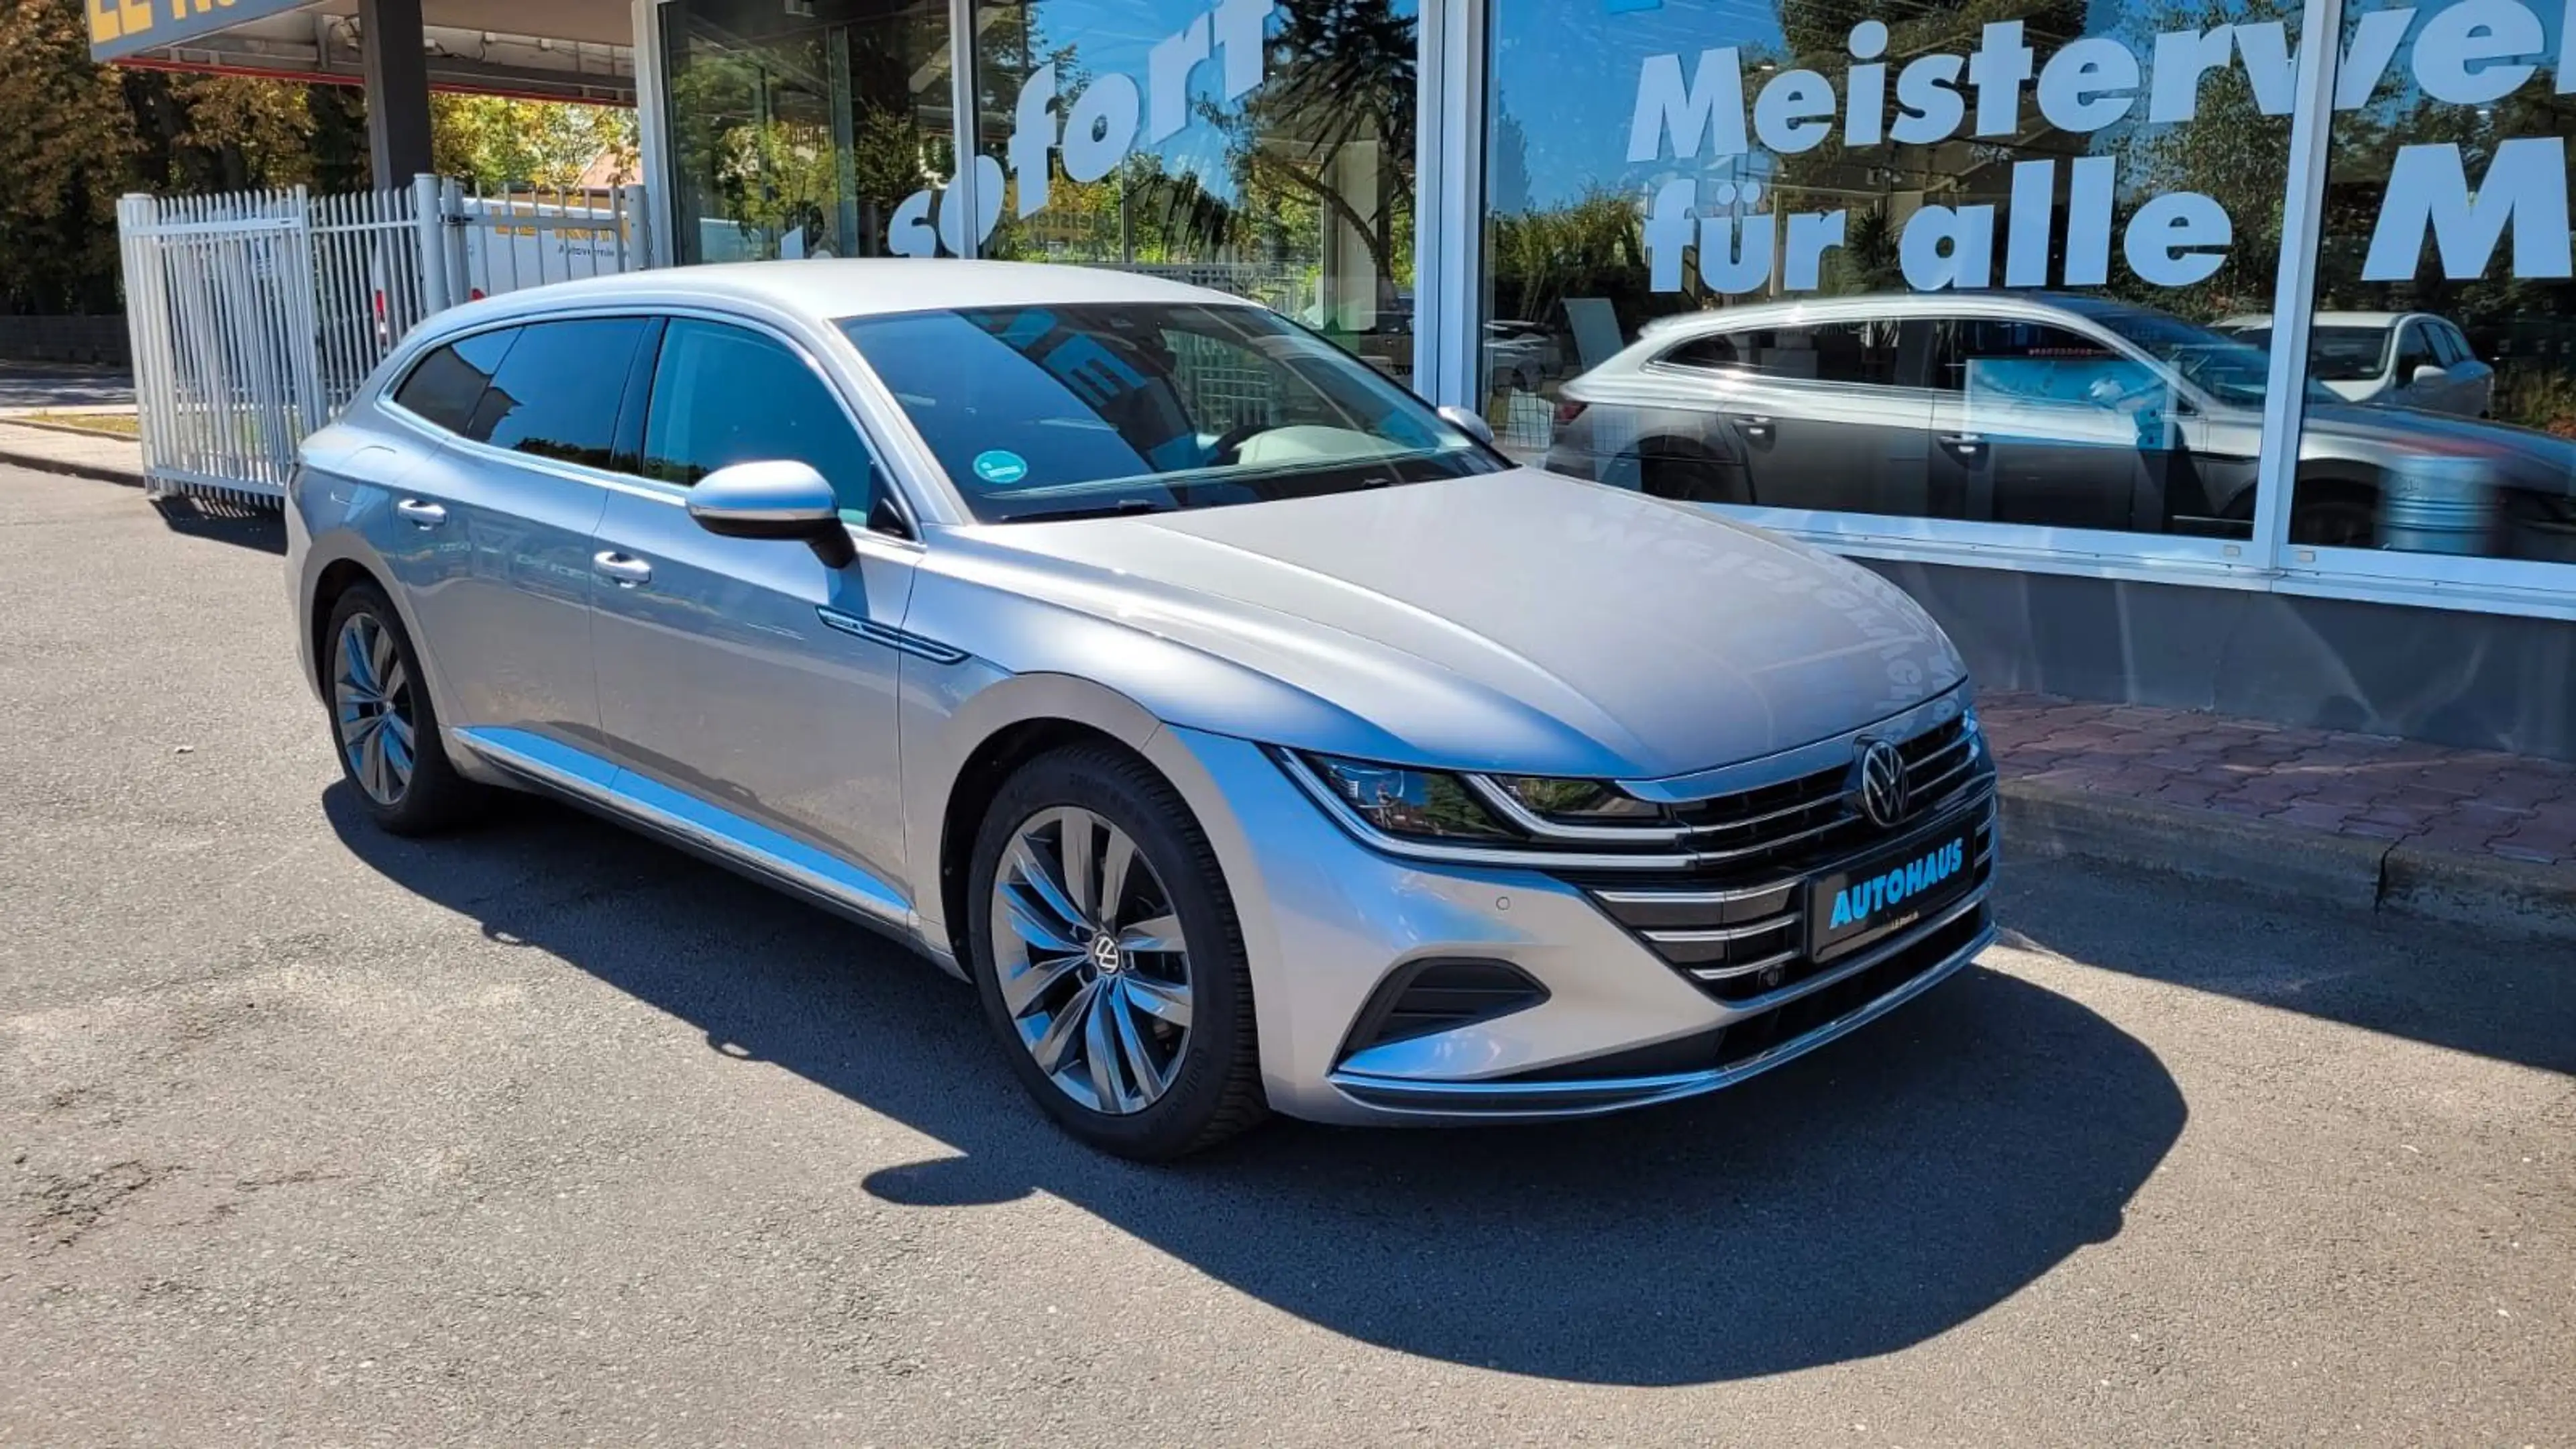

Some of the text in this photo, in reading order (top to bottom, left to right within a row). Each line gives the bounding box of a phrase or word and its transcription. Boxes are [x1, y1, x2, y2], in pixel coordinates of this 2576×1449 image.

[1643, 178, 1846, 294] für
[1899, 156, 2233, 291] alle
[1829, 837, 1964, 930] AUTOHAUS
